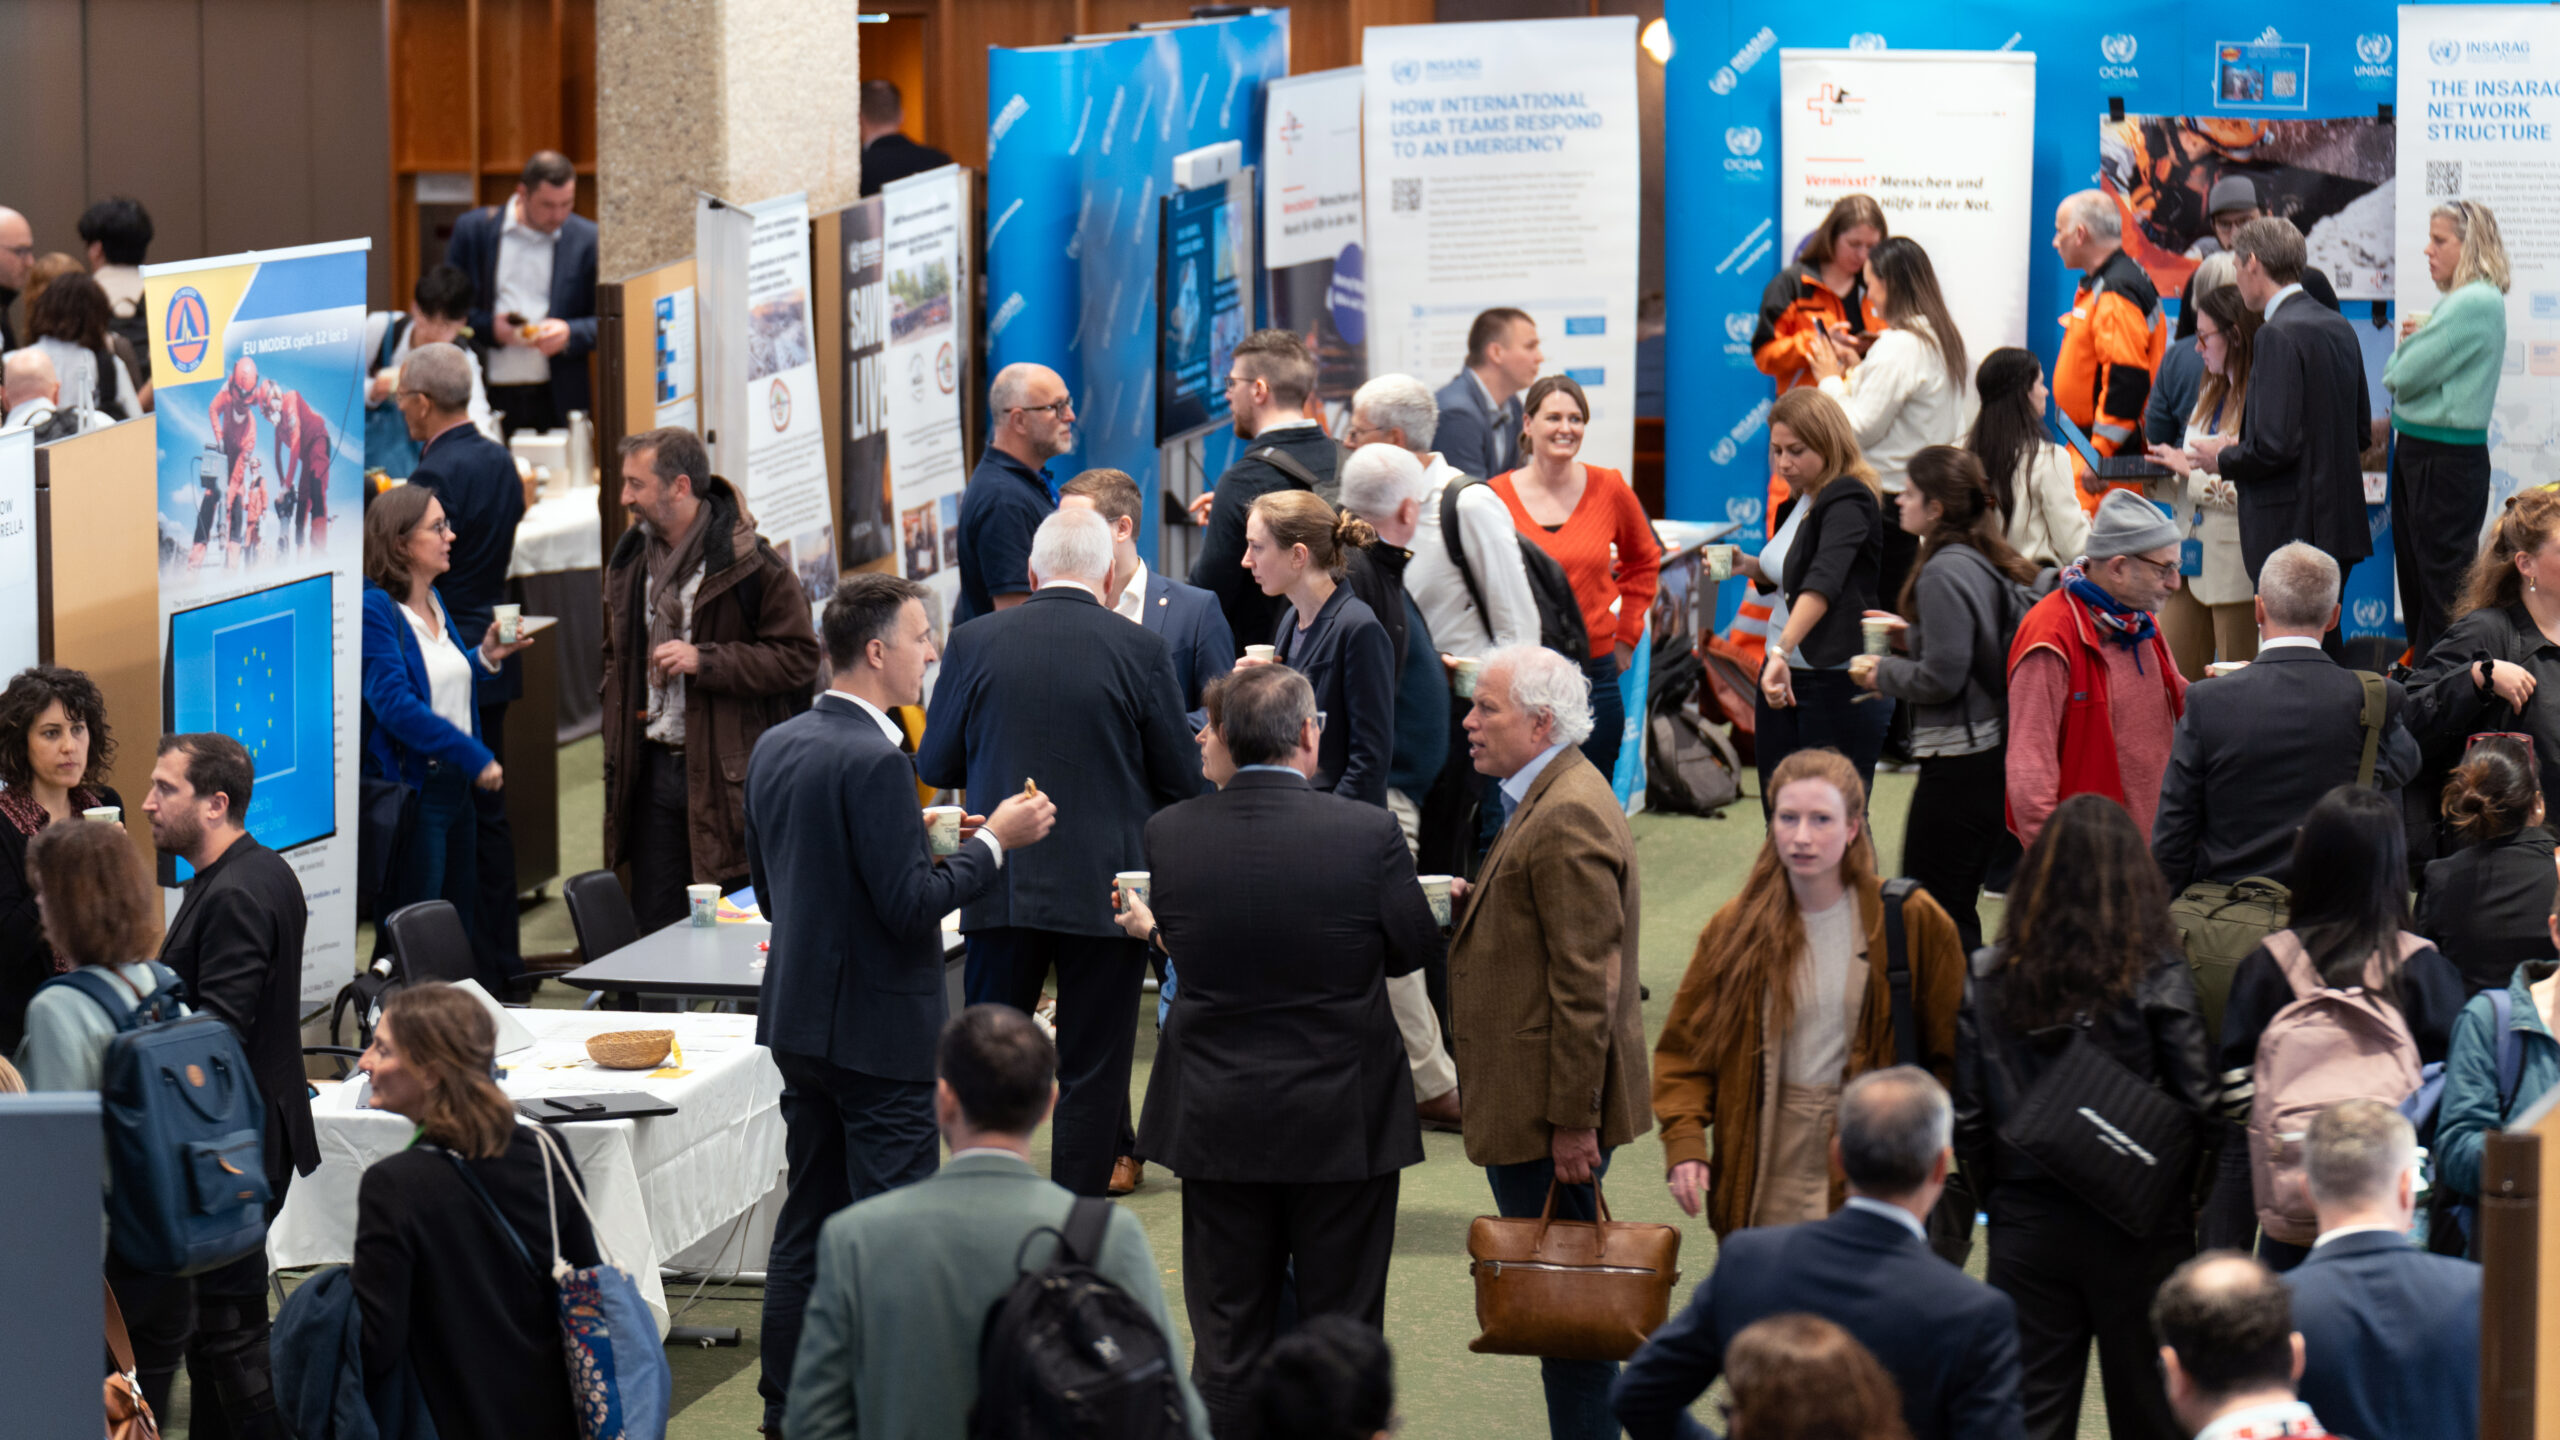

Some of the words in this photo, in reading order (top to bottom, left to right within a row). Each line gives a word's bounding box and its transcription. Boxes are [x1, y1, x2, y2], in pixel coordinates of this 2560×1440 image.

[2466, 41, 2530, 54] INSARAG
[2099, 66, 2139, 79] OCHA
[2354, 65, 2393, 77] UNDAC
[2427, 80, 2468, 97] THE
[1391, 99, 1434, 115] HOW
[1441, 92, 1588, 113] INTERNATIONAL
[2428, 102, 2531, 118] NETWORK
[1391, 119, 1441, 137] USAR
[1448, 115, 1509, 134] TEAMS
[1514, 112, 1602, 132] RESPOND
[2427, 123, 2551, 141] STRUCTURE
[1391, 141, 1416, 158] TO
[1423, 139, 1448, 156] AN
[1454, 135, 1565, 156] EMERGENCY
[1723, 158, 1763, 172] OCHA
[1805, 174, 1877, 187] Vermisst?
[1880, 176, 1951, 189] Menschen
[1957, 177, 1984, 189] und
[1805, 197, 1835, 208] Hun
[1881, 197, 1914, 212] Hilfe
[1919, 198, 1932, 209] in
[1936, 198, 1959, 210] der
[1964, 199, 1992, 211] Not.
[243, 340, 257, 355] EU
[258, 335, 292, 353] MODEX
[293, 333, 313, 351] cycle
[316, 330, 327, 345] 12
